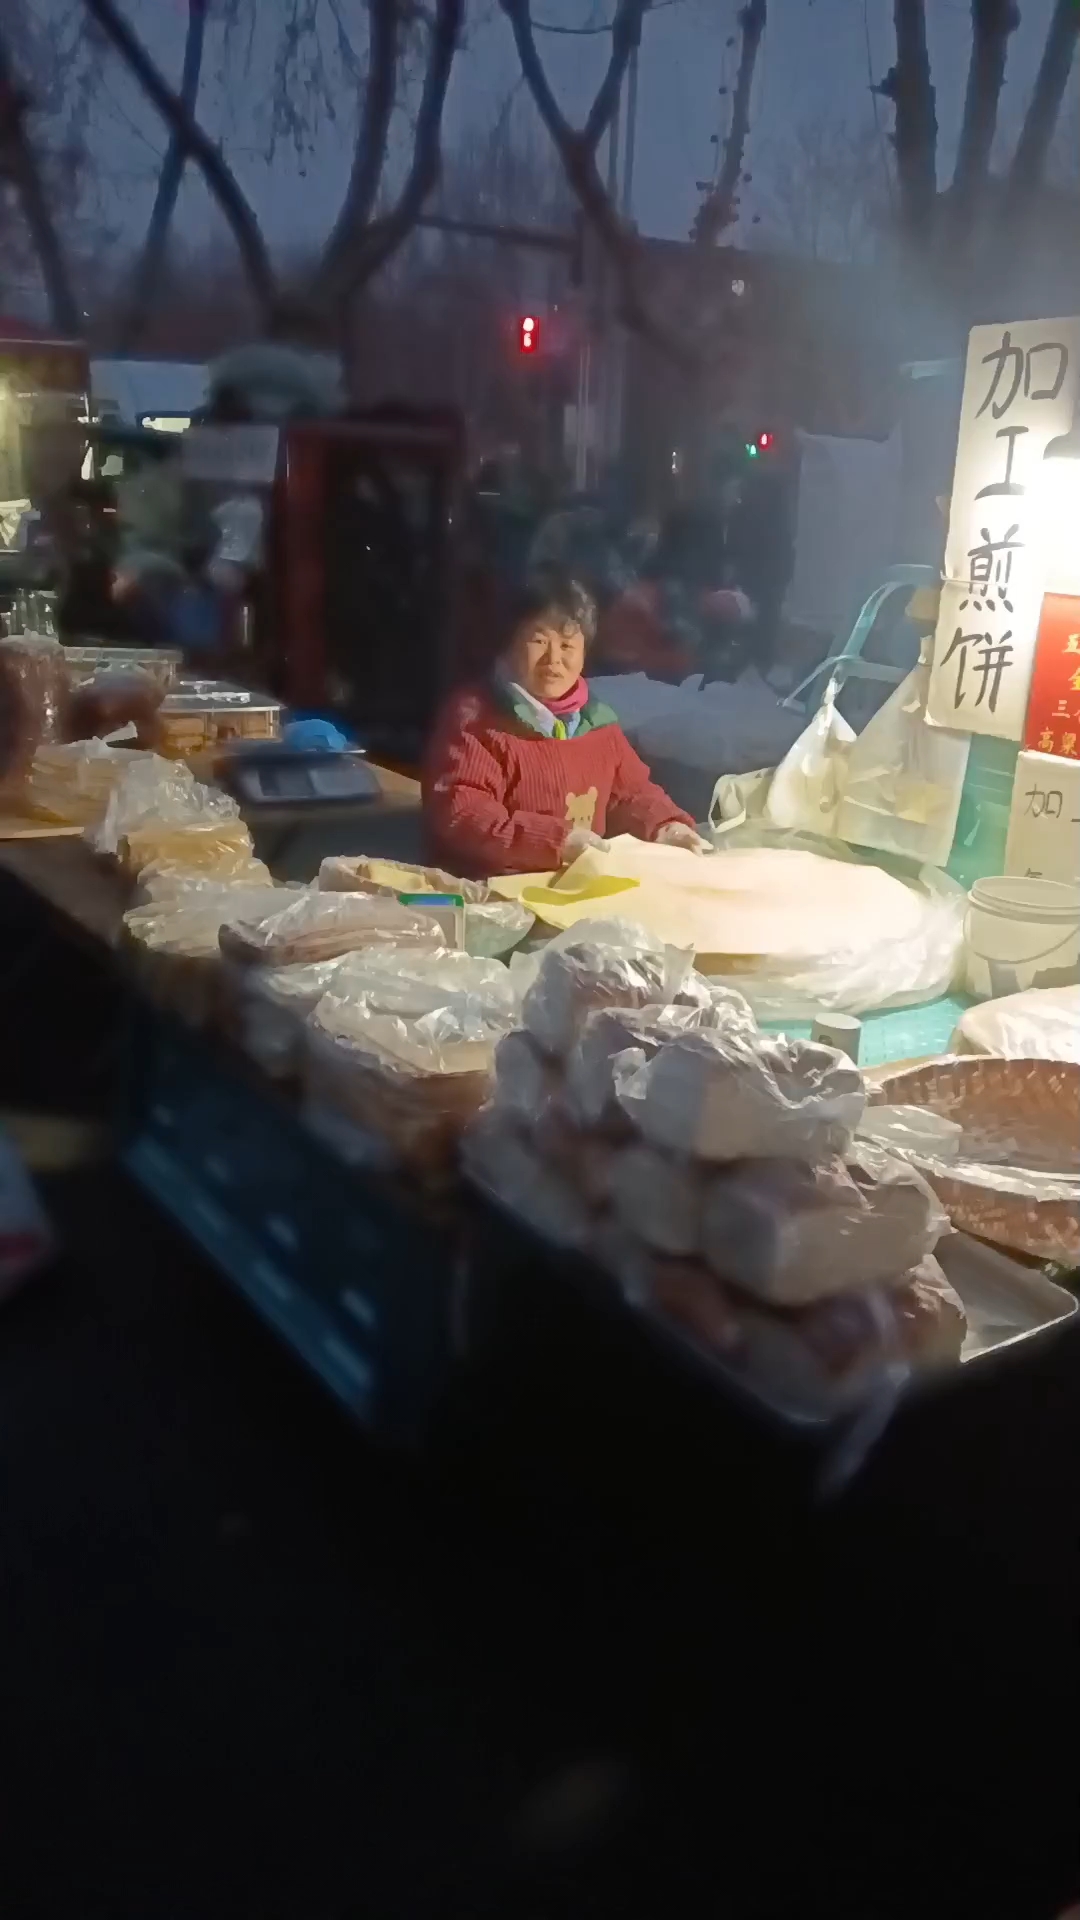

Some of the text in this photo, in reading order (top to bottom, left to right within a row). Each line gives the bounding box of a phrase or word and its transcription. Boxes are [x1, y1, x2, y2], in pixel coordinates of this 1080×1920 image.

[940, 331, 1068, 713] 加工煎饼
[1052, 699, 1080, 724] 三
